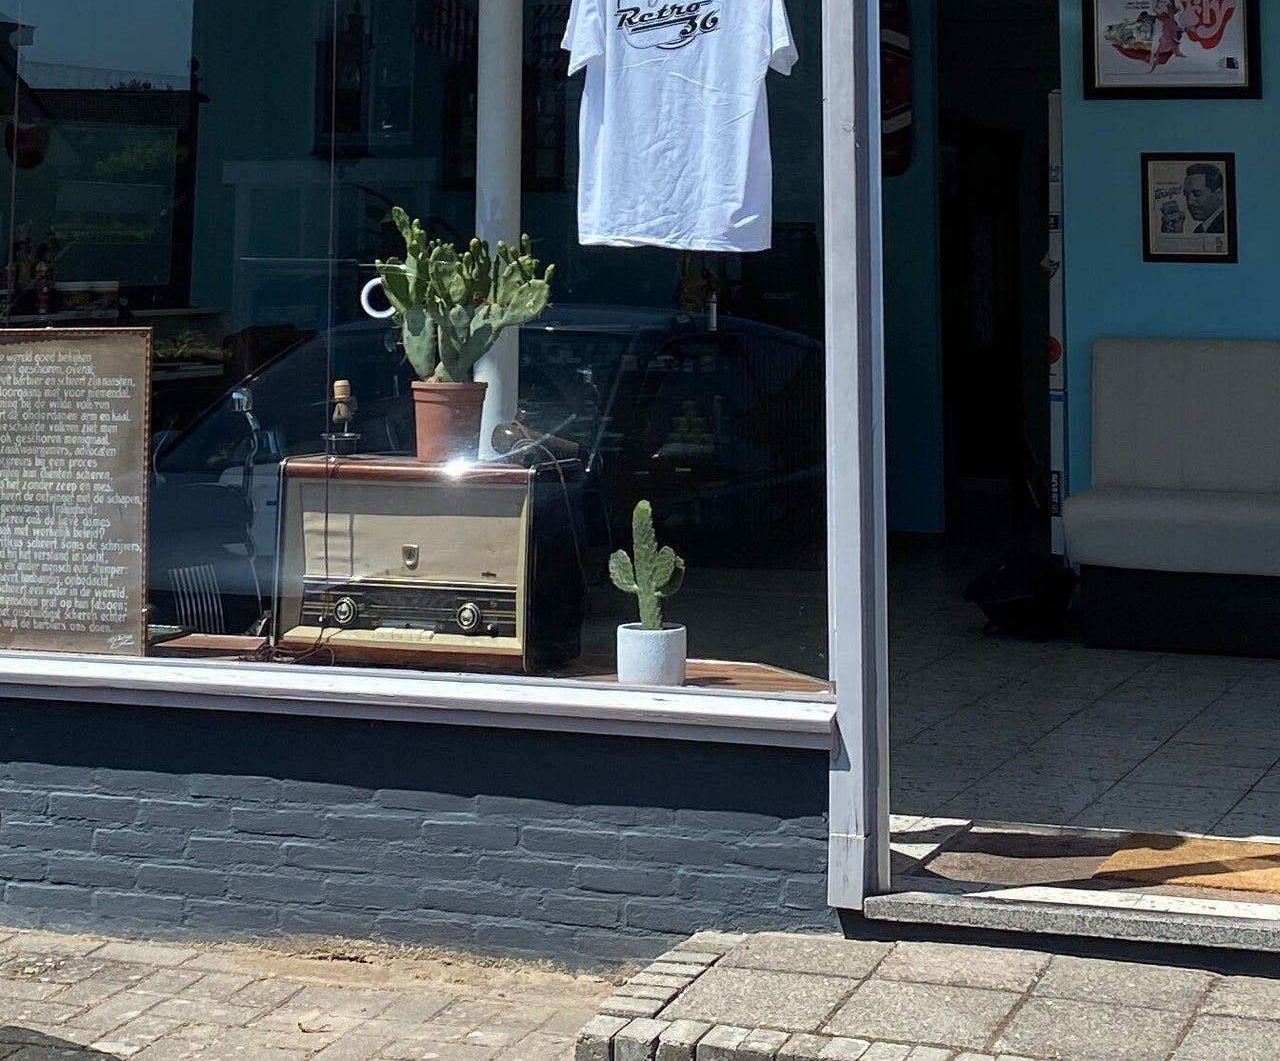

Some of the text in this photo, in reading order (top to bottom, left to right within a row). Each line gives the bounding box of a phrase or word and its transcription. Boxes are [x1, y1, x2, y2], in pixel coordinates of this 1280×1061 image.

[616, 0, 713, 30] Retro
[679, 9, 720, 37] 36
[63, 389, 86, 398] voor
[100, 413, 110, 421] en
[69, 458, 98, 471] proces
[21, 479, 53, 490] zonder
[55, 482, 77, 497] zeep
[60, 599, 72, 610] op
